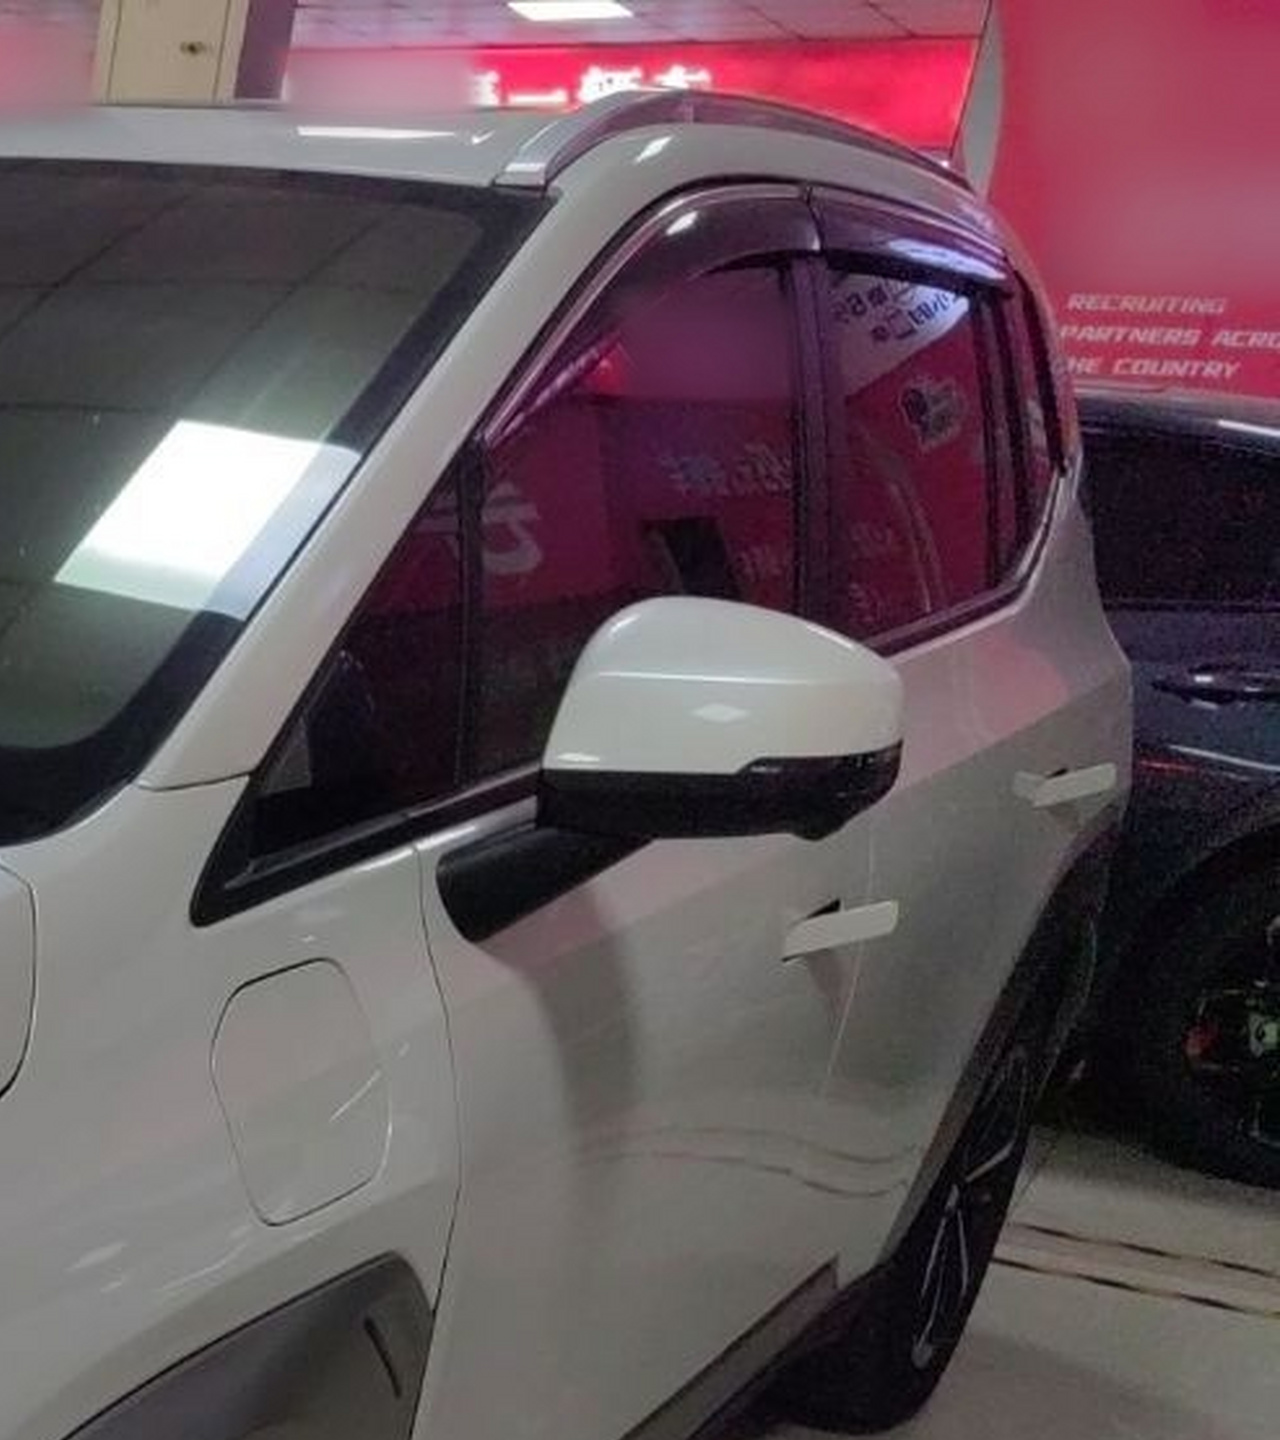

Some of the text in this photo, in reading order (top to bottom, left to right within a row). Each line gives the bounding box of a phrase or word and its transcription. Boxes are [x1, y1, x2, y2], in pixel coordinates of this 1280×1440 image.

[1067, 295, 1225, 314] RECRUITING
[1061, 326, 1201, 345] PARTNERS
[1113, 359, 1240, 378] COUNTRY
